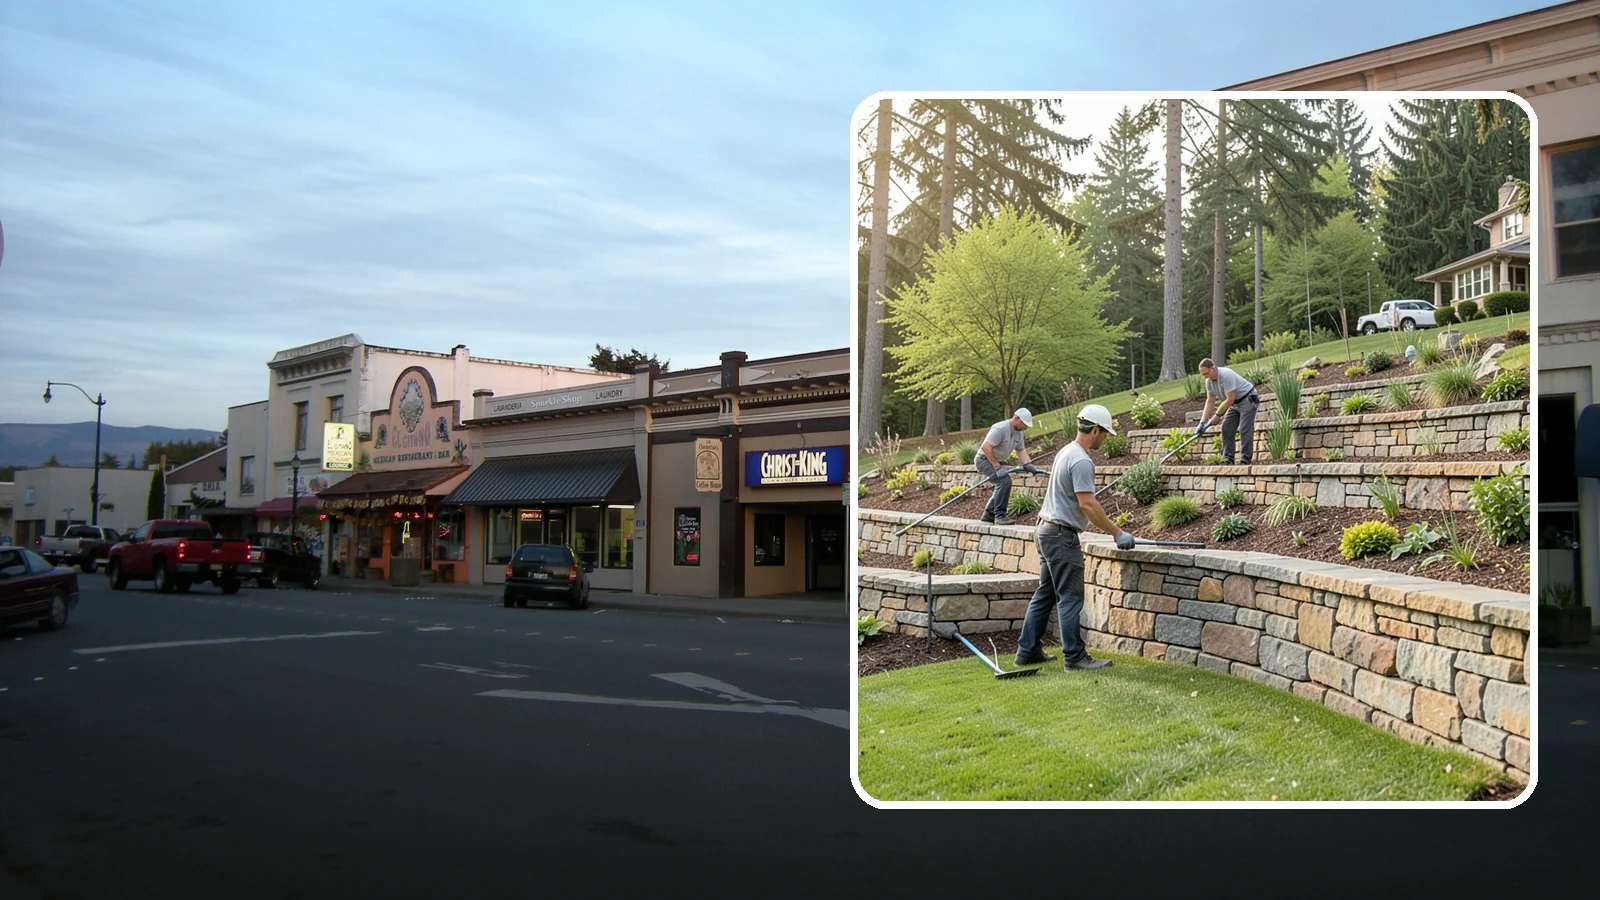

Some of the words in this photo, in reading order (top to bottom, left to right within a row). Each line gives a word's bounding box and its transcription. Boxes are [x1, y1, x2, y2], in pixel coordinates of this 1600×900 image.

[561, 394, 582, 405] Shop
[595, 389, 623, 400] LAUNDRY
[493, 402, 522, 413] LAVANDERIA
[373, 454, 396, 464] MEXICAN
[397, 451, 434, 462] RESTAURANT
[437, 450, 450, 459] BAR
[761, 452, 797, 478] CHRIST
[799, 450, 827, 476] KING
